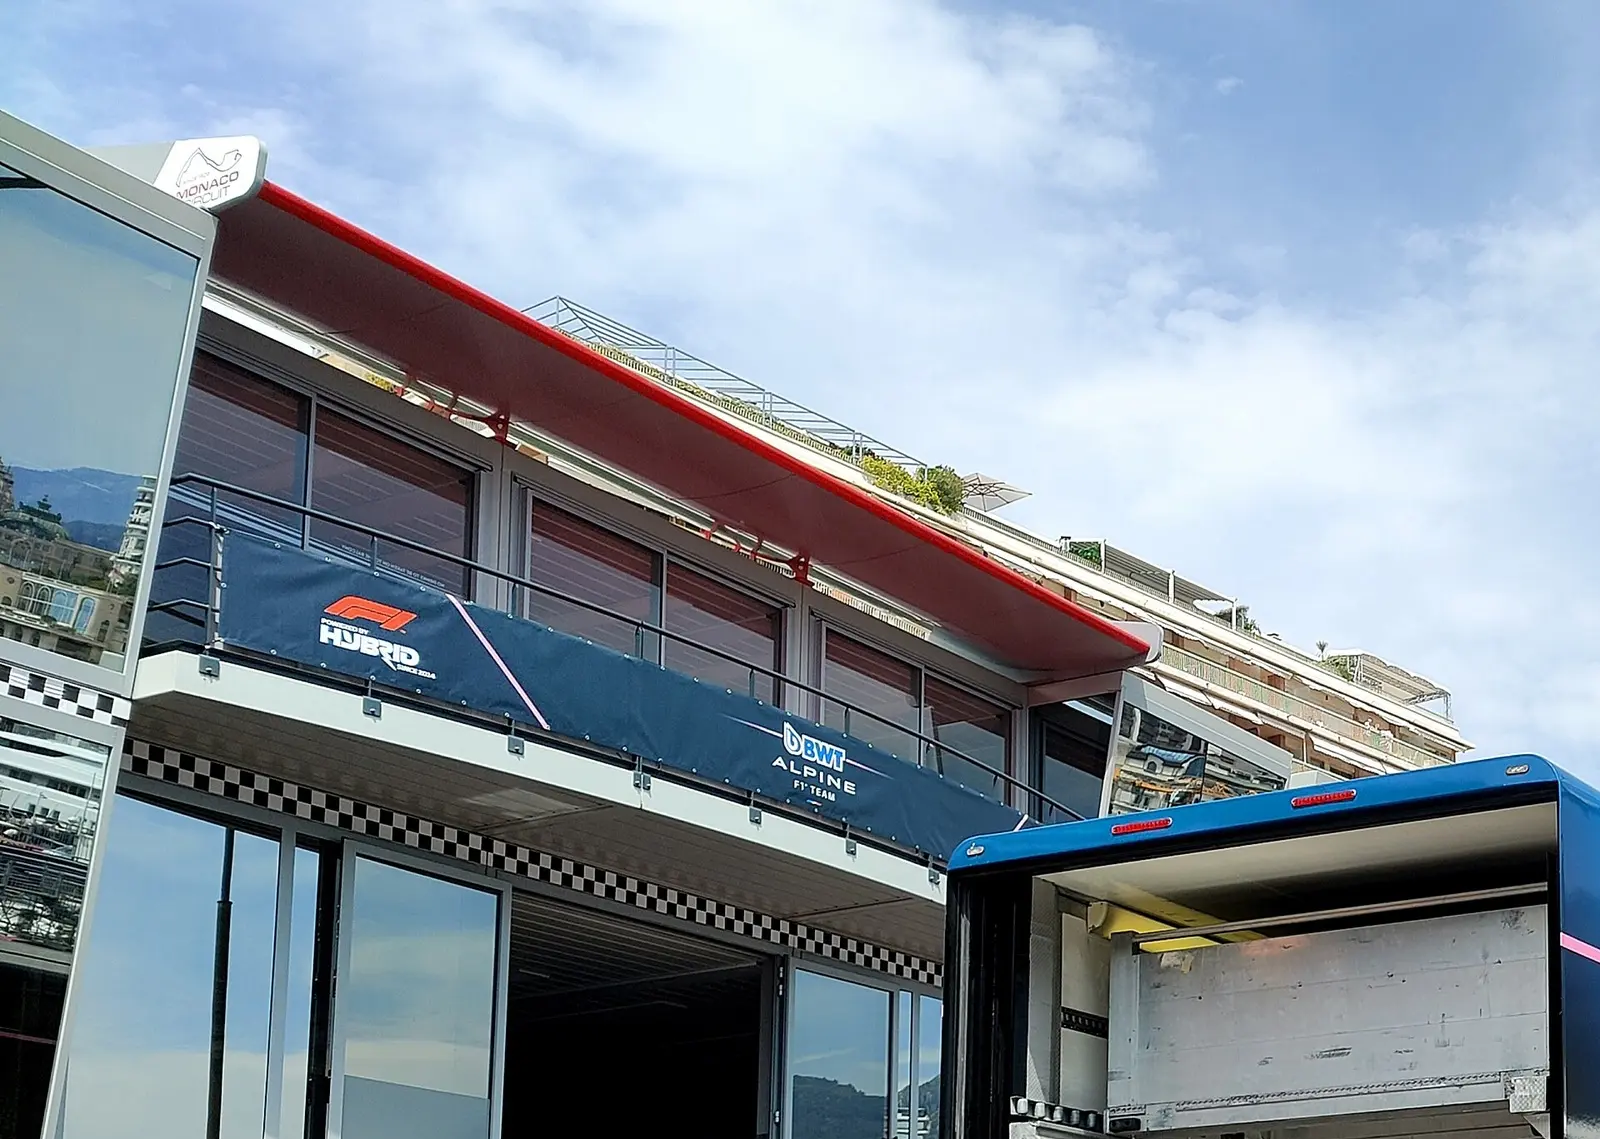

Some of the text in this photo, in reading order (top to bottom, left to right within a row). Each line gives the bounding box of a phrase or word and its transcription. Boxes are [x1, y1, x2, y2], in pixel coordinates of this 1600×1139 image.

[176, 171, 239, 199] MONACO
[320, 624, 420, 671] HYBRID
[358, 627, 369, 635] BY
[802, 734, 846, 772] BWT
[772, 756, 856, 795] ALPINE
[810, 785, 836, 802] TEAM
